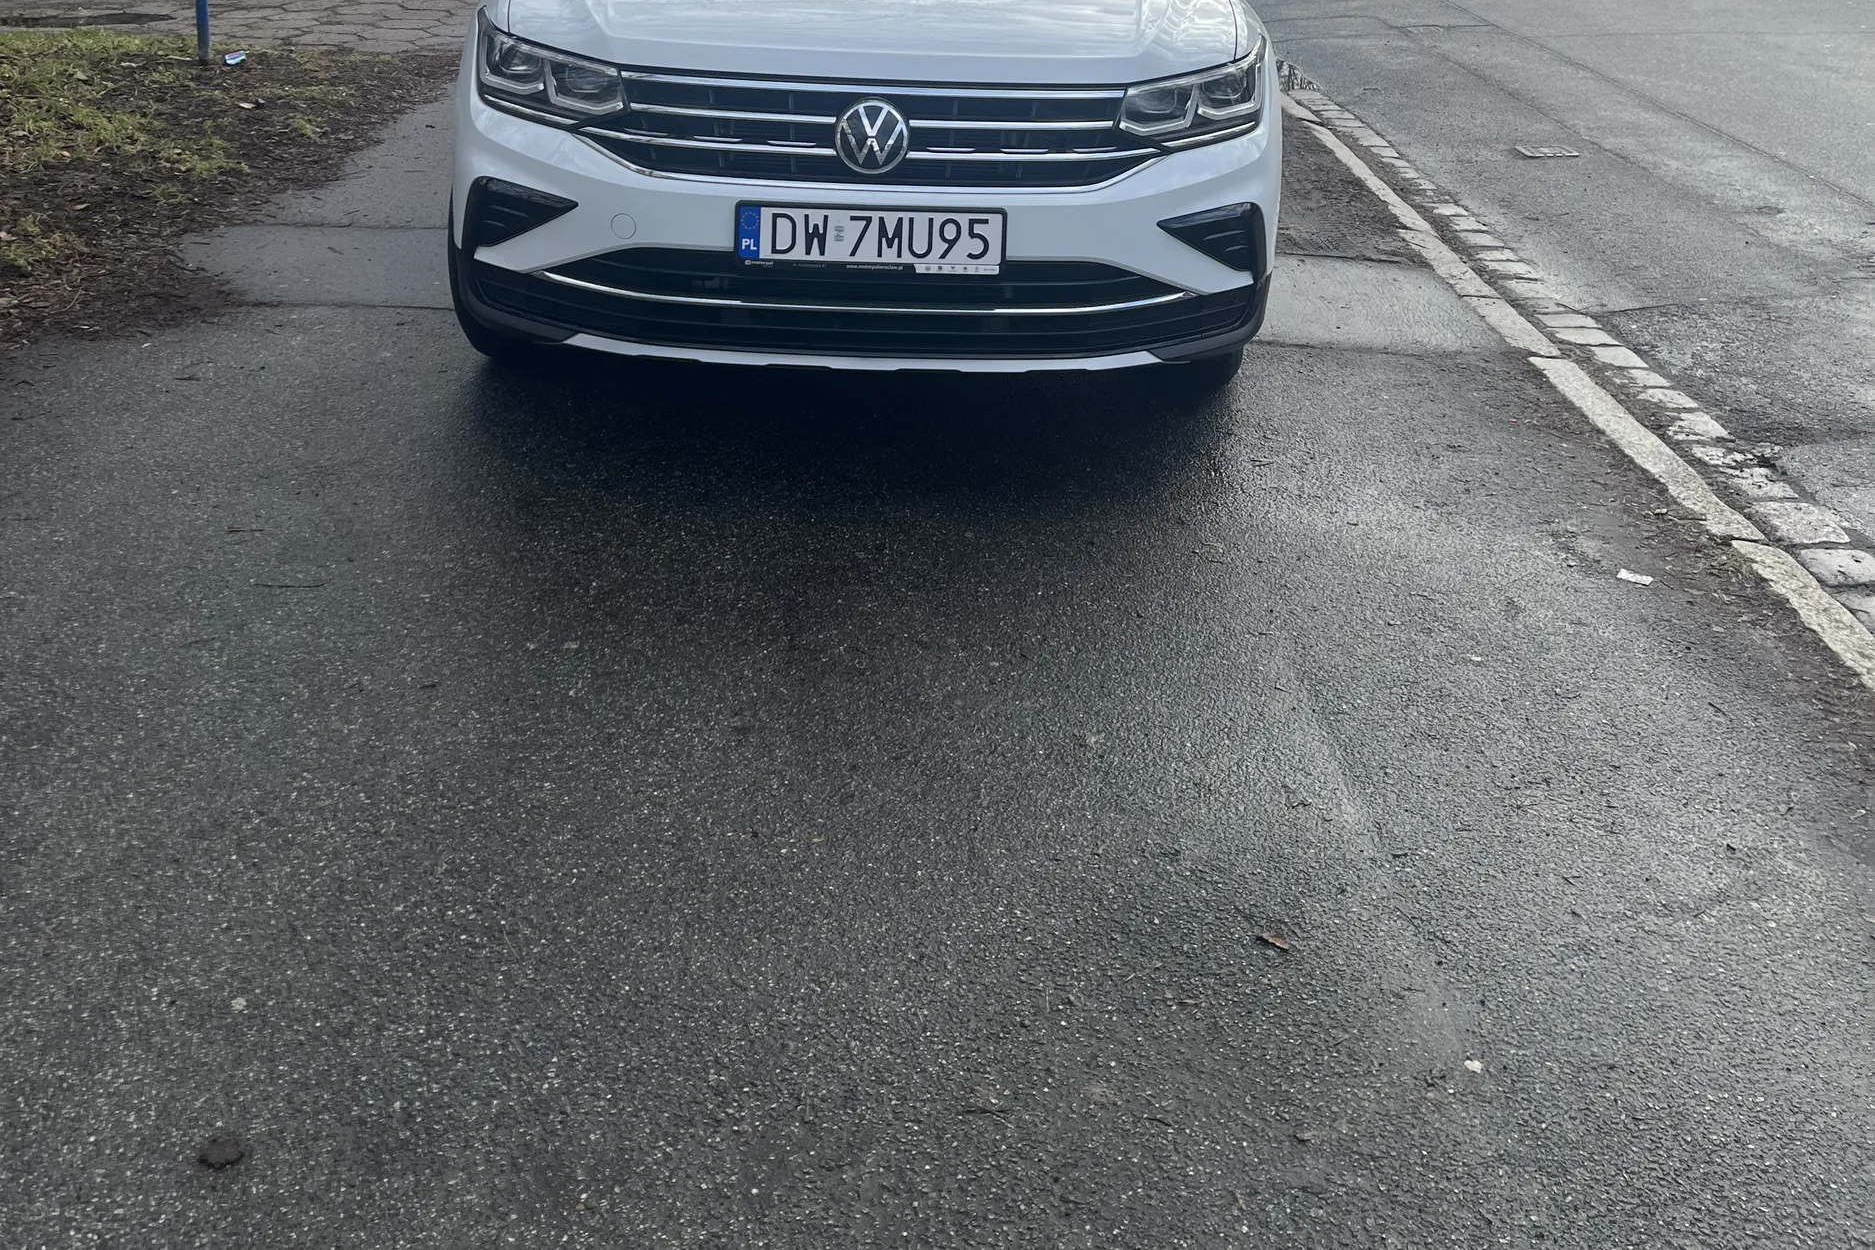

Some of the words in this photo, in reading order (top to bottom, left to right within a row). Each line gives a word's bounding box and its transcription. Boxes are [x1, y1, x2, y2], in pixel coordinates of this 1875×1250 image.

[741, 238, 757, 250] PL
[771, 212, 829, 256] DW
[849, 215, 989, 260] 7MU95
